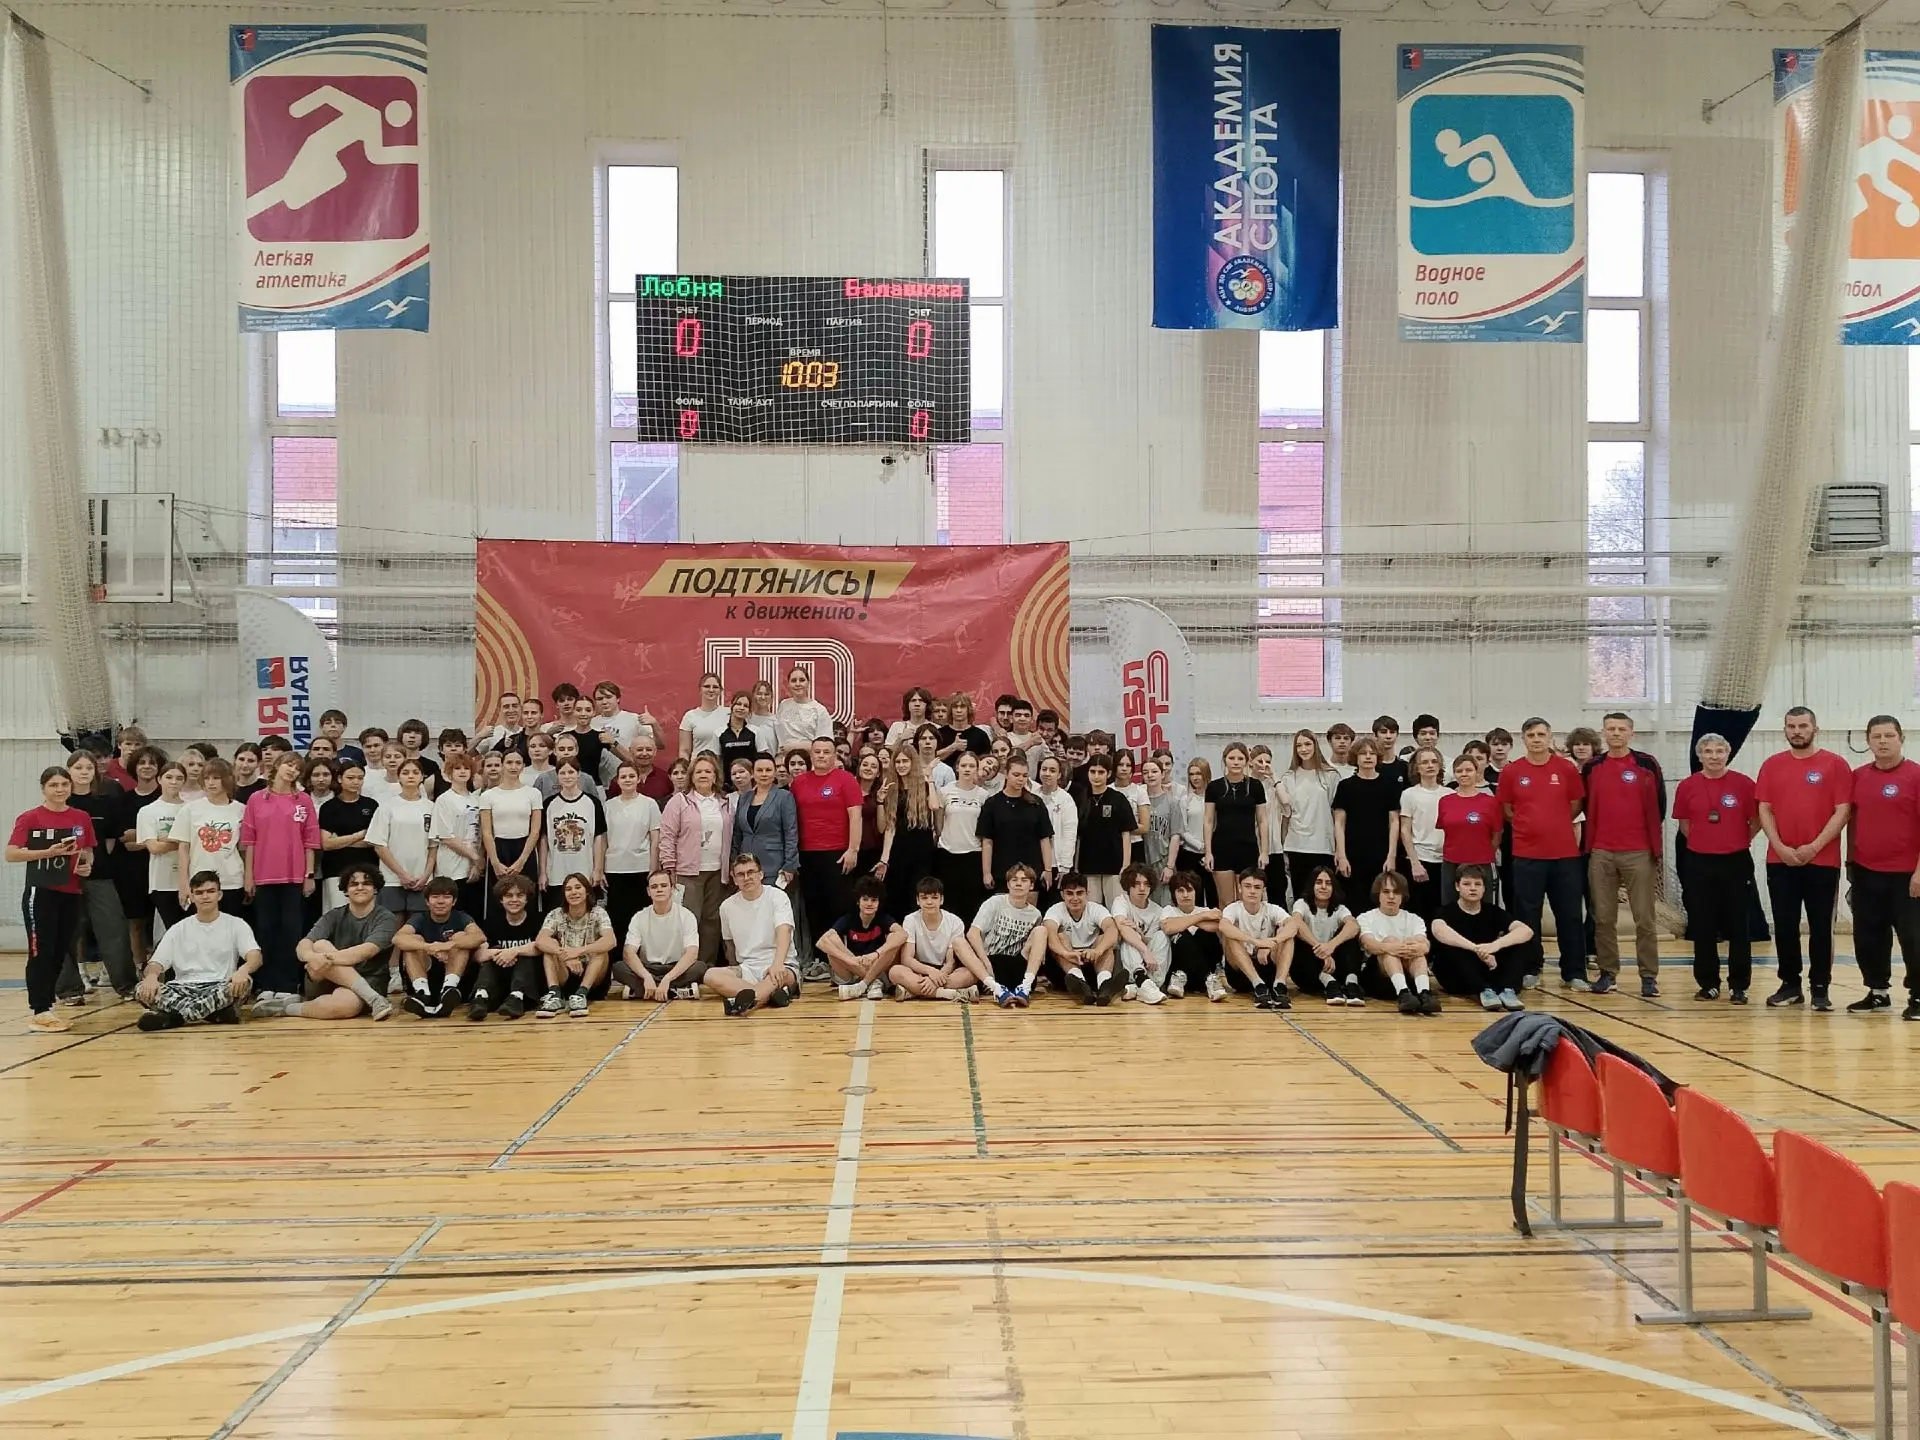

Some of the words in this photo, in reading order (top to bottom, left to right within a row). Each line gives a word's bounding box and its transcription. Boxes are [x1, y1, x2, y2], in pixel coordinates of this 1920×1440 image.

[1213, 43, 1246, 249] АКАДЕМИЯ
[1248, 103, 1279, 251] СПОРТА
[254, 250, 314, 269] Легкая
[256, 270, 348, 289] атлетика
[1415, 264, 1486, 285] Водное
[641, 277, 724, 297] Лобня
[844, 278, 963, 298] Балашиха
[1415, 287, 1460, 306] поло
[745, 317, 783, 327] ПЕРИОД
[826, 317, 863, 326] ПАРТИЯ
[908, 308, 932, 317] СЧЕТ
[676, 318, 702, 357] 0
[907, 320, 932, 358] 0
[789, 348, 821, 357] ВРЕМЯ
[675, 397, 704, 406] ФОЛЫ
[728, 398, 774, 407] ТАЙМ-АУТ
[821, 400, 842, 408] СЧЕТ
[857, 400, 899, 408] ПАРТИЯМ
[907, 400, 935, 408] ФОЛЫ
[724, 604, 737, 620] к
[743, 600, 856, 621] движению
